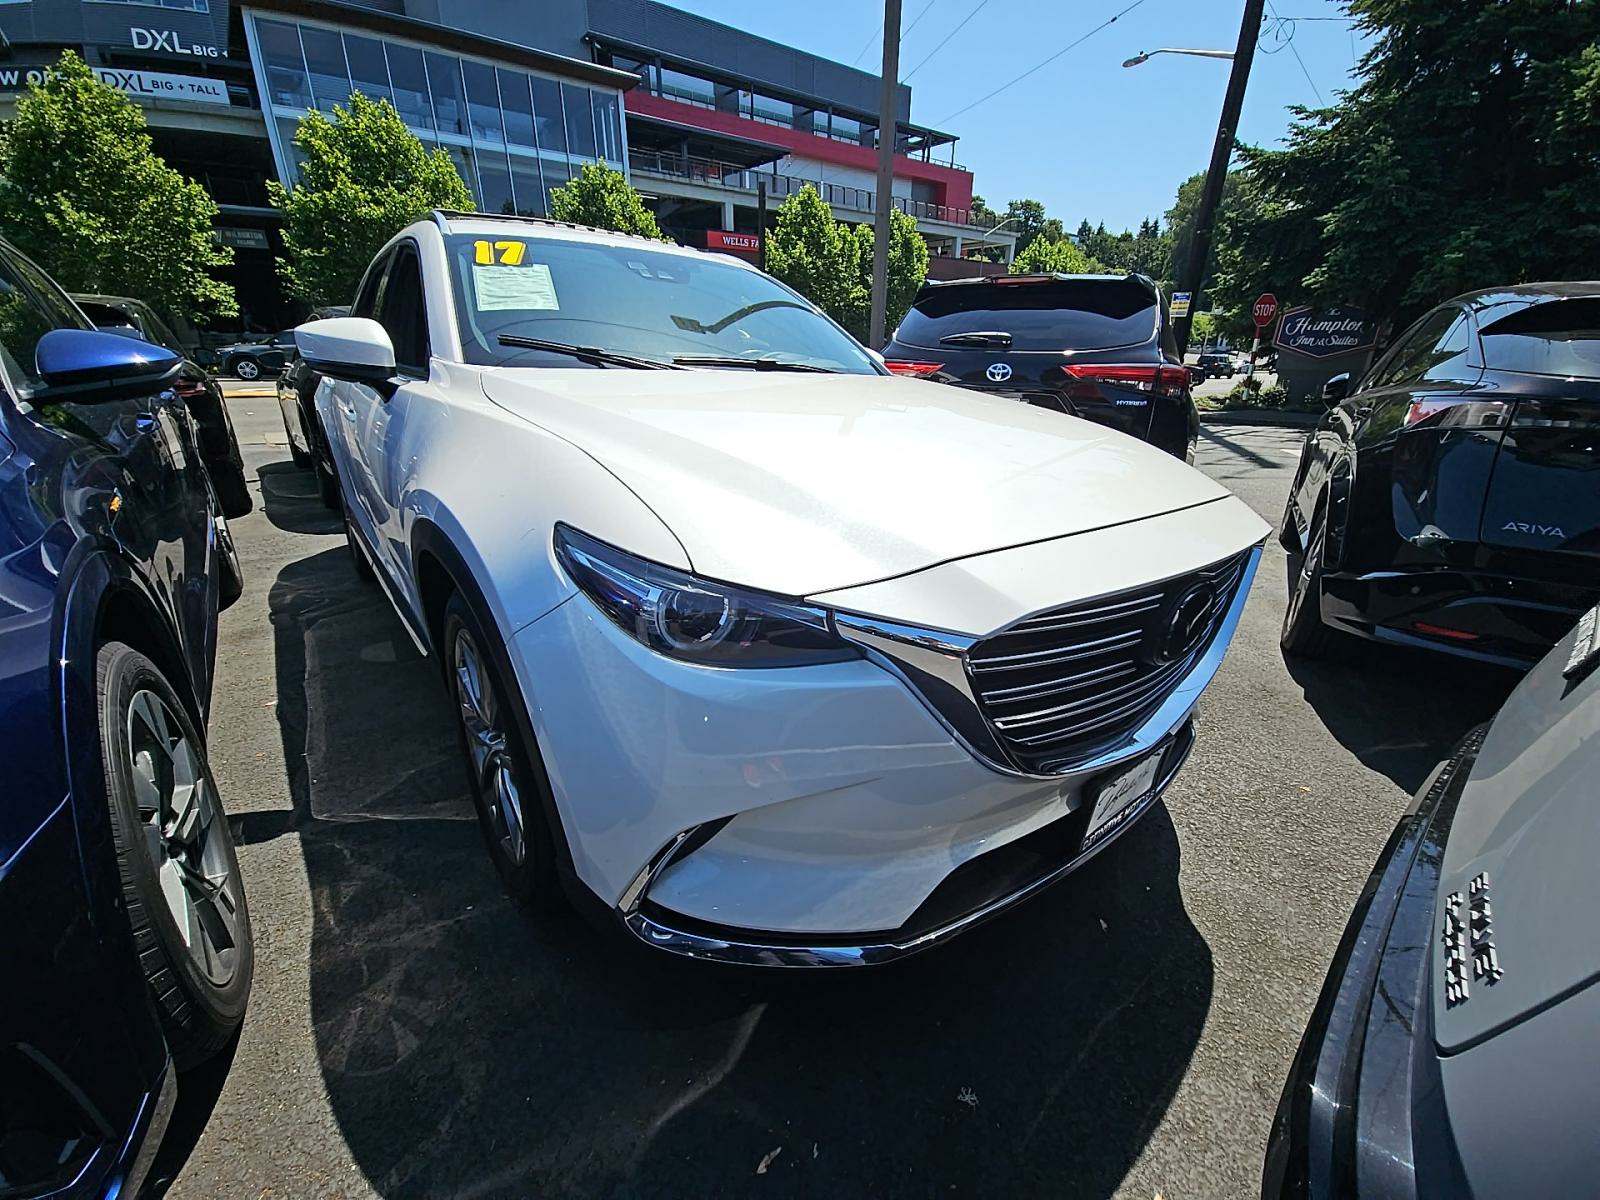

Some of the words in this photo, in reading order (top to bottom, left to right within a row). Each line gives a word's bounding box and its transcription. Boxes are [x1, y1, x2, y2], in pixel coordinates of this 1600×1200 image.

[130, 27, 191, 54] DXL
[192, 44, 218, 58] BIG
[101, 71, 154, 92] DXL
[151, 80, 174, 91] BIG
[188, 84, 220, 96] TALL
[722, 236, 749, 247] WELLS
[473, 240, 527, 265] 17
[1255, 304, 1276, 316] STOP
[1289, 335, 1320, 347] Inn
[1325, 334, 1358, 346] Suites
[1501, 521, 1567, 539] ARIYA
